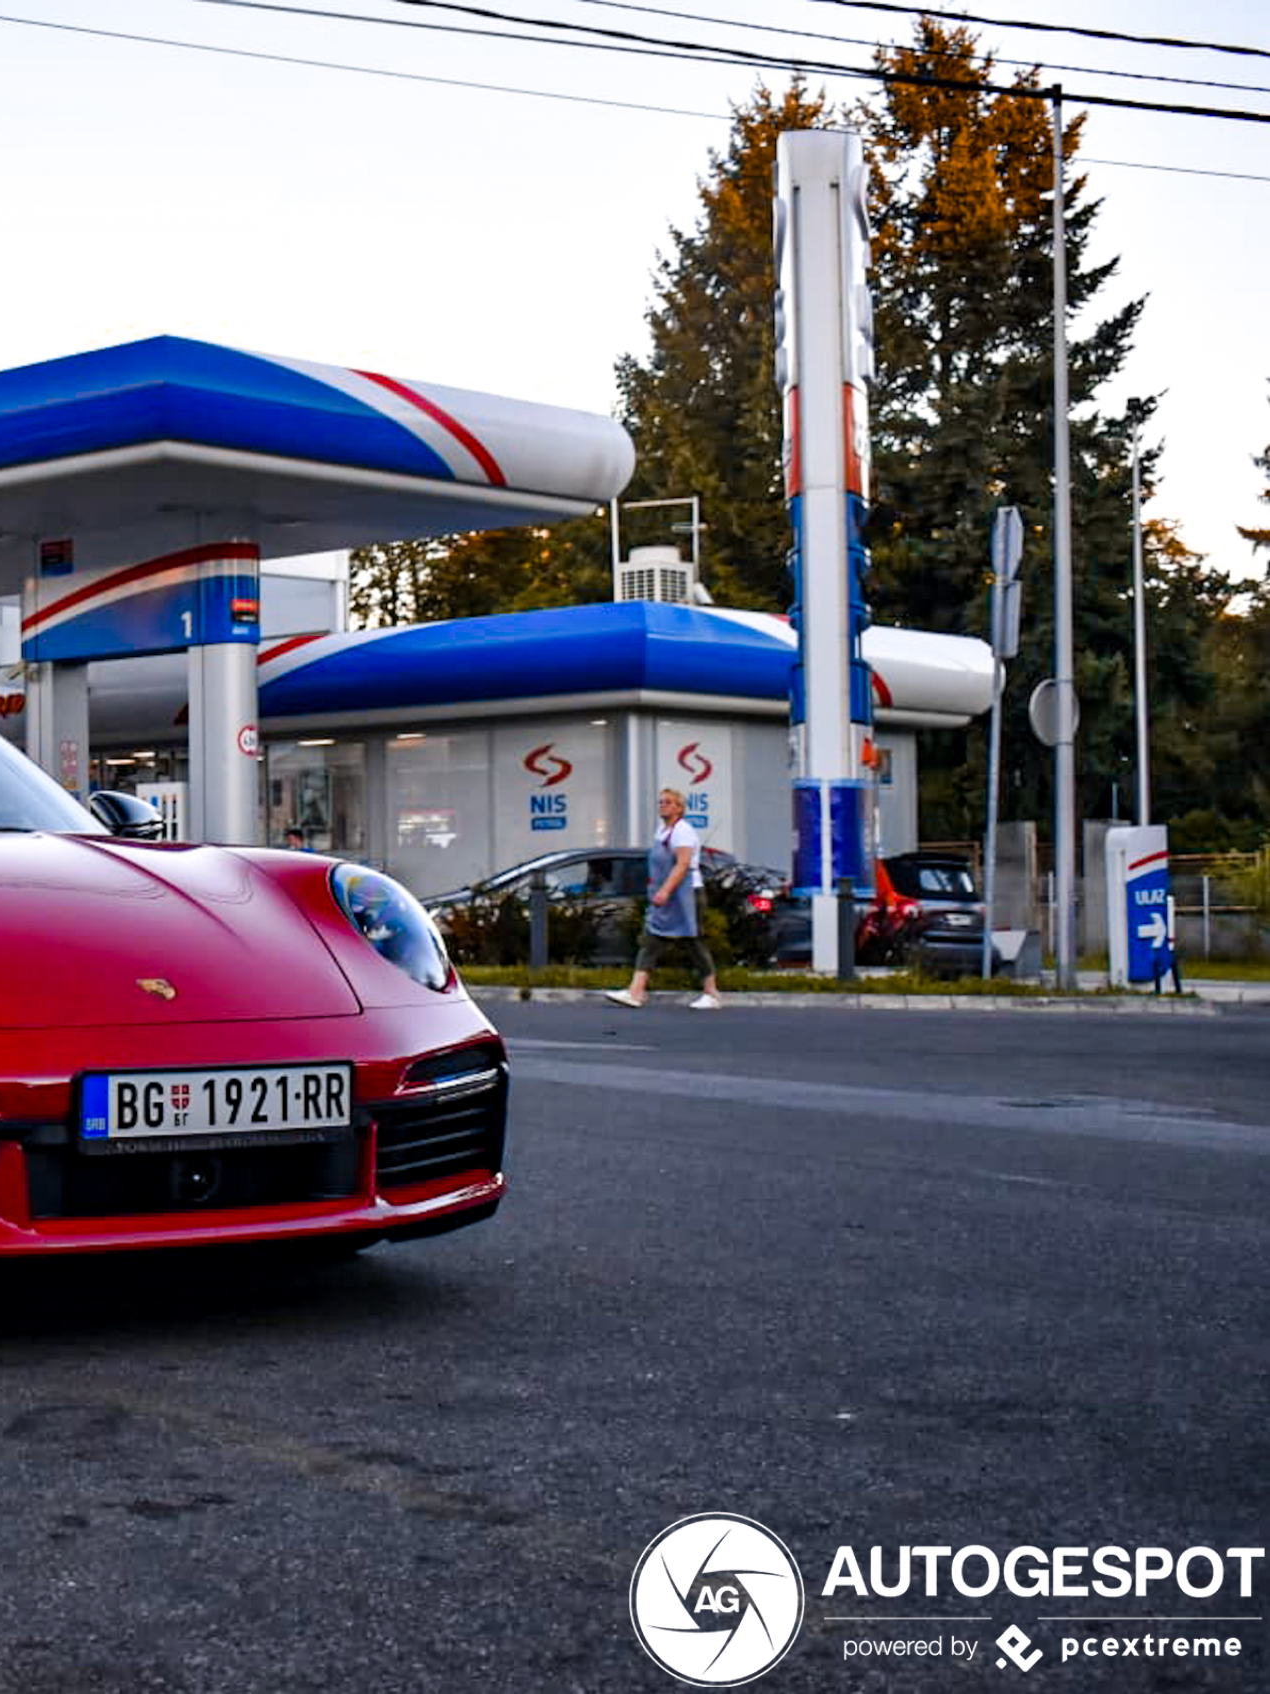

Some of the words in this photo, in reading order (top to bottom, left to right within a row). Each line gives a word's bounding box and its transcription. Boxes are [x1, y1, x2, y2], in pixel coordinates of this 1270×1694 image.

[181, 610, 193, 639] 1
[530, 793, 567, 814] NIS
[1134, 889, 1166, 905] ULAZ
[117, 1081, 165, 1130] BG
